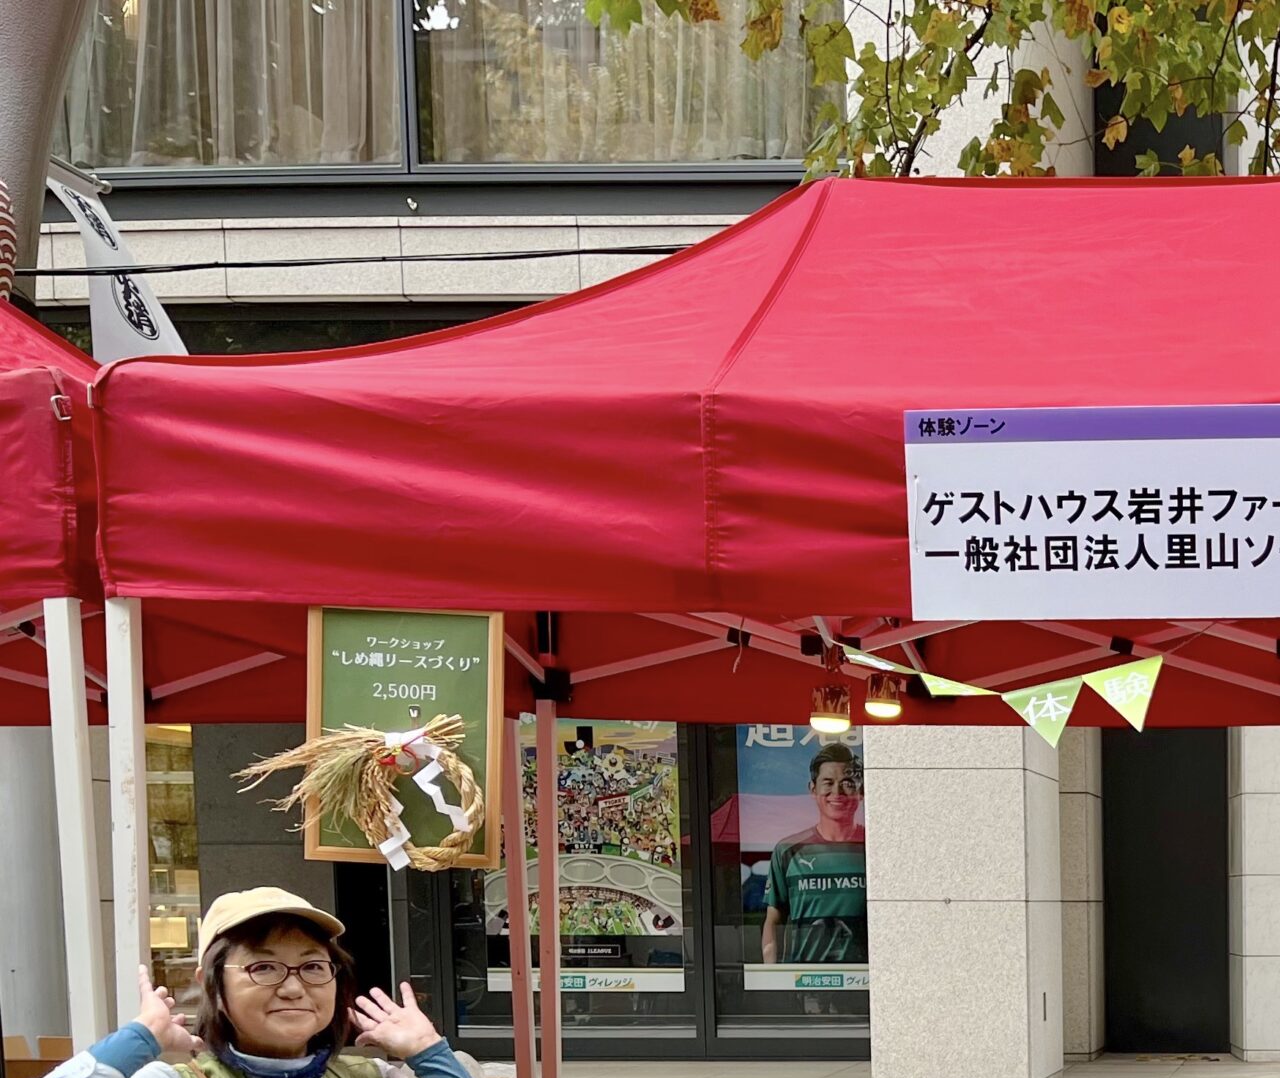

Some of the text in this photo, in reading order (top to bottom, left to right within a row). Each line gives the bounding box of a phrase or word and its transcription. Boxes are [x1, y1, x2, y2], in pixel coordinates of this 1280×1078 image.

[918, 417, 1006, 437] 体験ゾーン
[366, 636, 445, 650] ワークショップ
[372, 683, 436, 701] 2,500円
[798, 878, 832, 891] MEIJI
